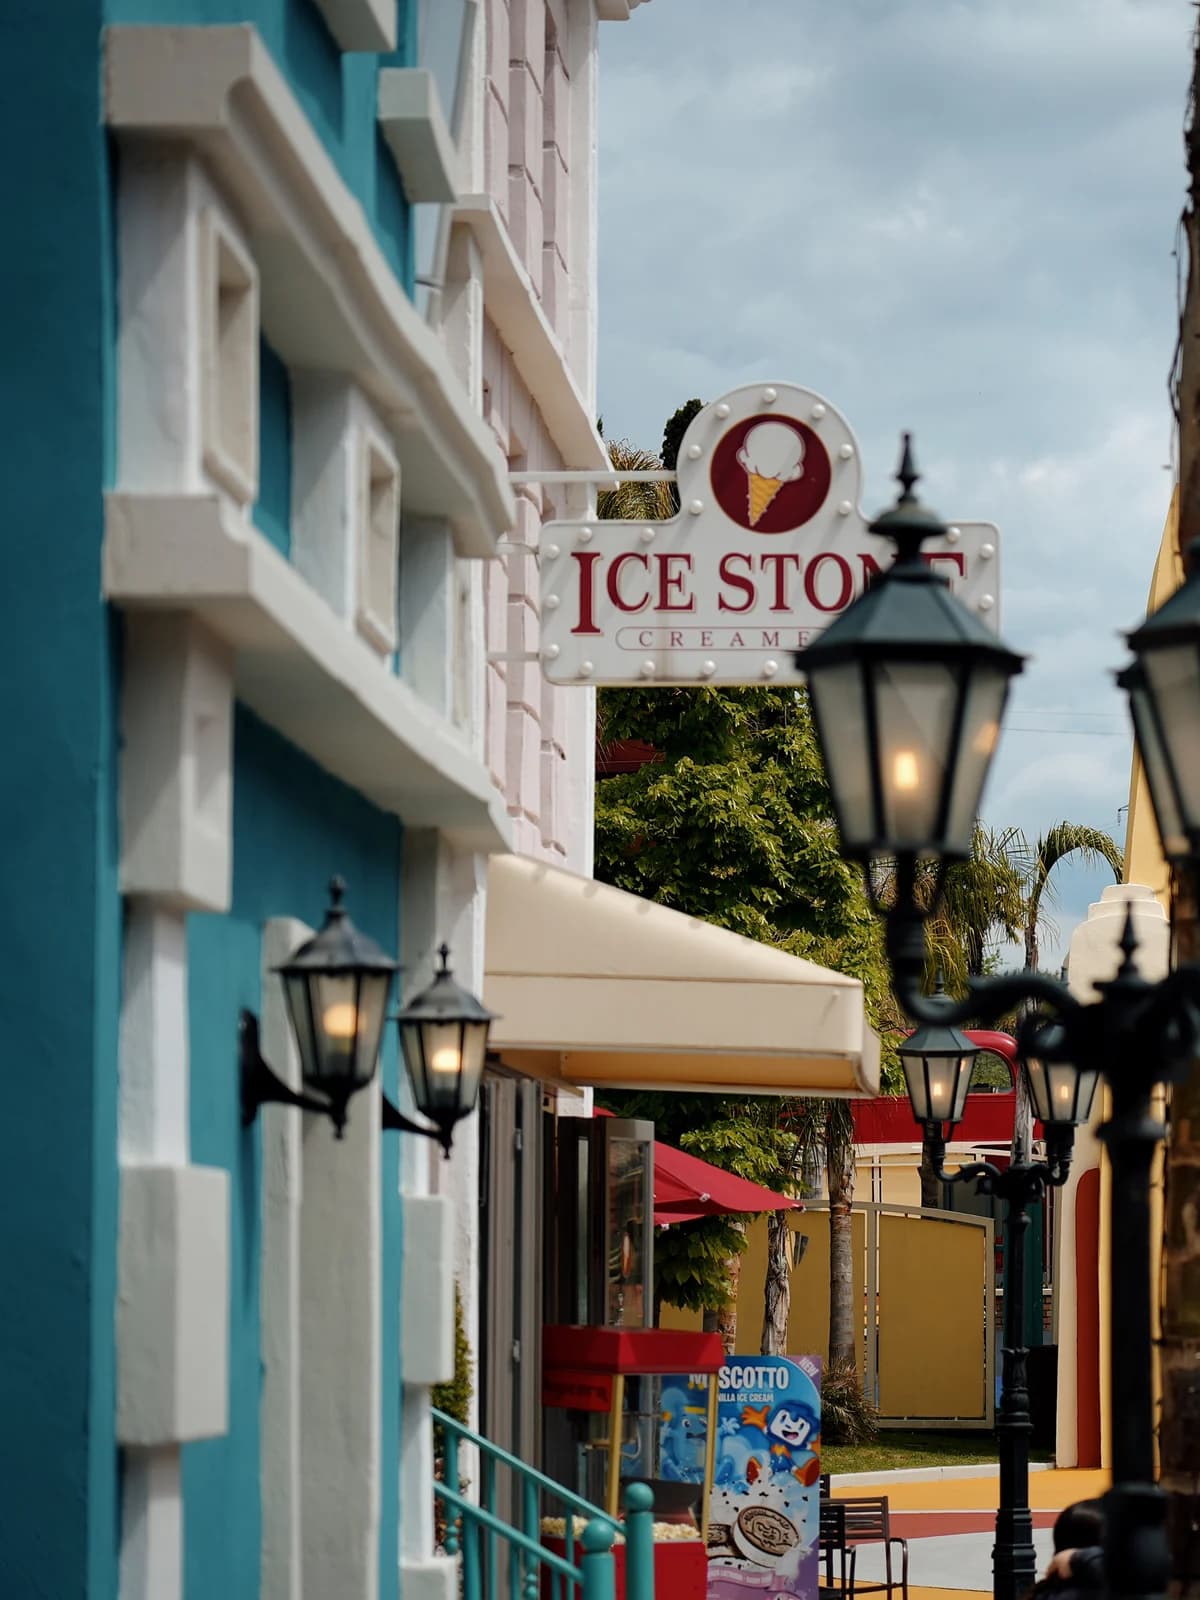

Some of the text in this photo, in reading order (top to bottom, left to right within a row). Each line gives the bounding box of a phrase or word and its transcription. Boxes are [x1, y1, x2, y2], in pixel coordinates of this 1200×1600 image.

[570, 552, 696, 636] ICE
[638, 630, 811, 648] CREAME
[737, 1392, 748, 1403] ICE
[749, 1392, 774, 1403] CREAM
